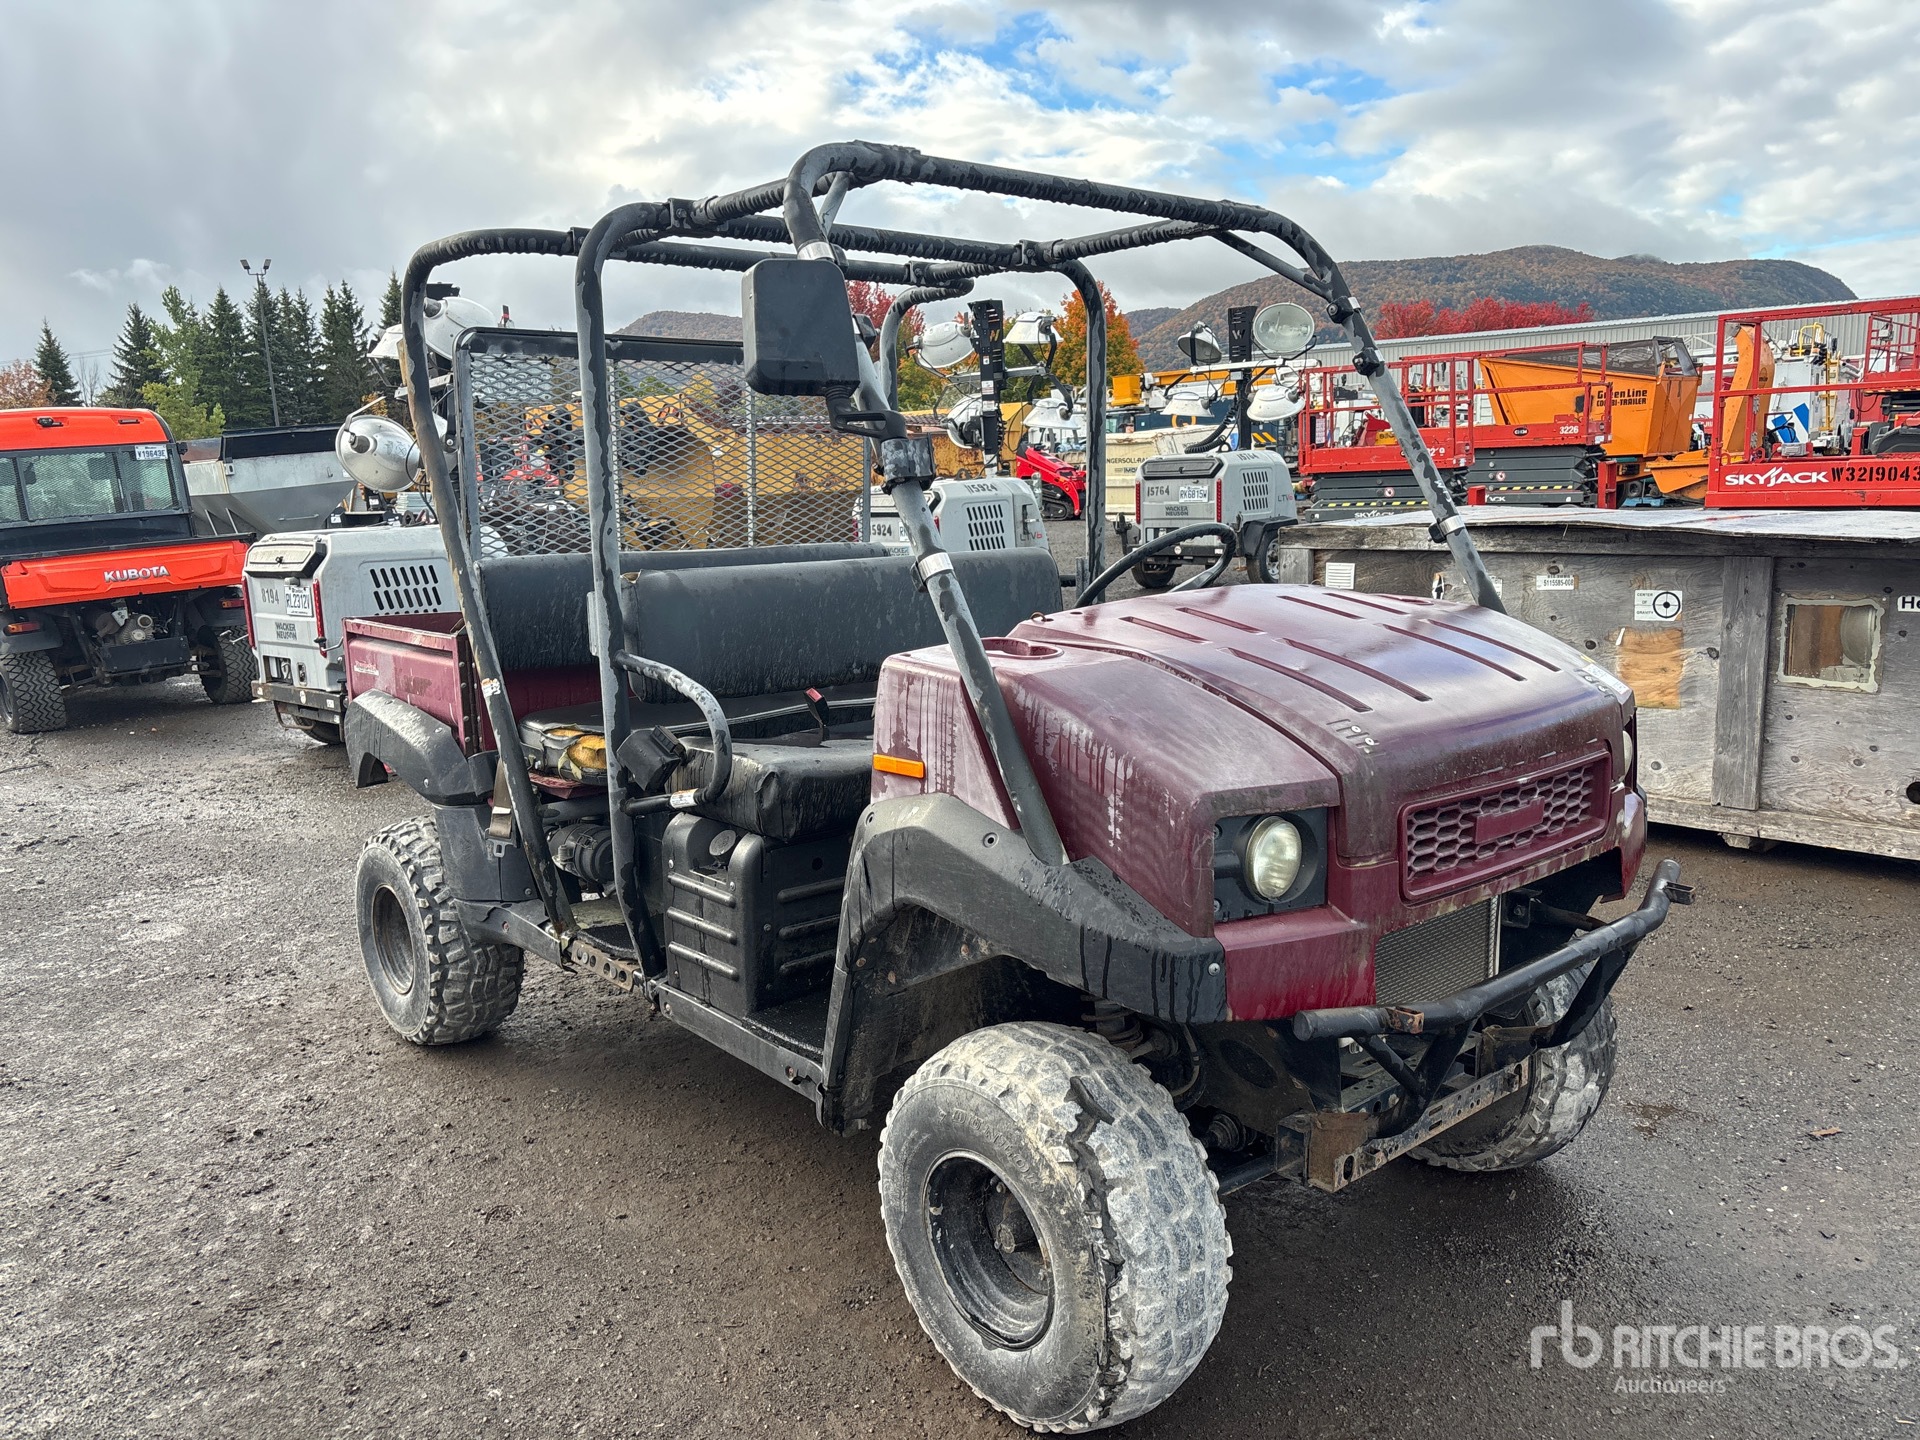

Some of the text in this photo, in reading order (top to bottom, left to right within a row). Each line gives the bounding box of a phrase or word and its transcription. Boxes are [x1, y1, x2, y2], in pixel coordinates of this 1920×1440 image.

[1627, 388, 1648, 398] Line
[1559, 425, 1579, 435] 3226
[1725, 466, 1829, 487] SKYJACK
[1147, 485, 1170, 497] 15764
[103, 565, 170, 583] KUBOTA
[275, 622, 296, 632] WACKER
[276, 631, 298, 640] NEUSON
